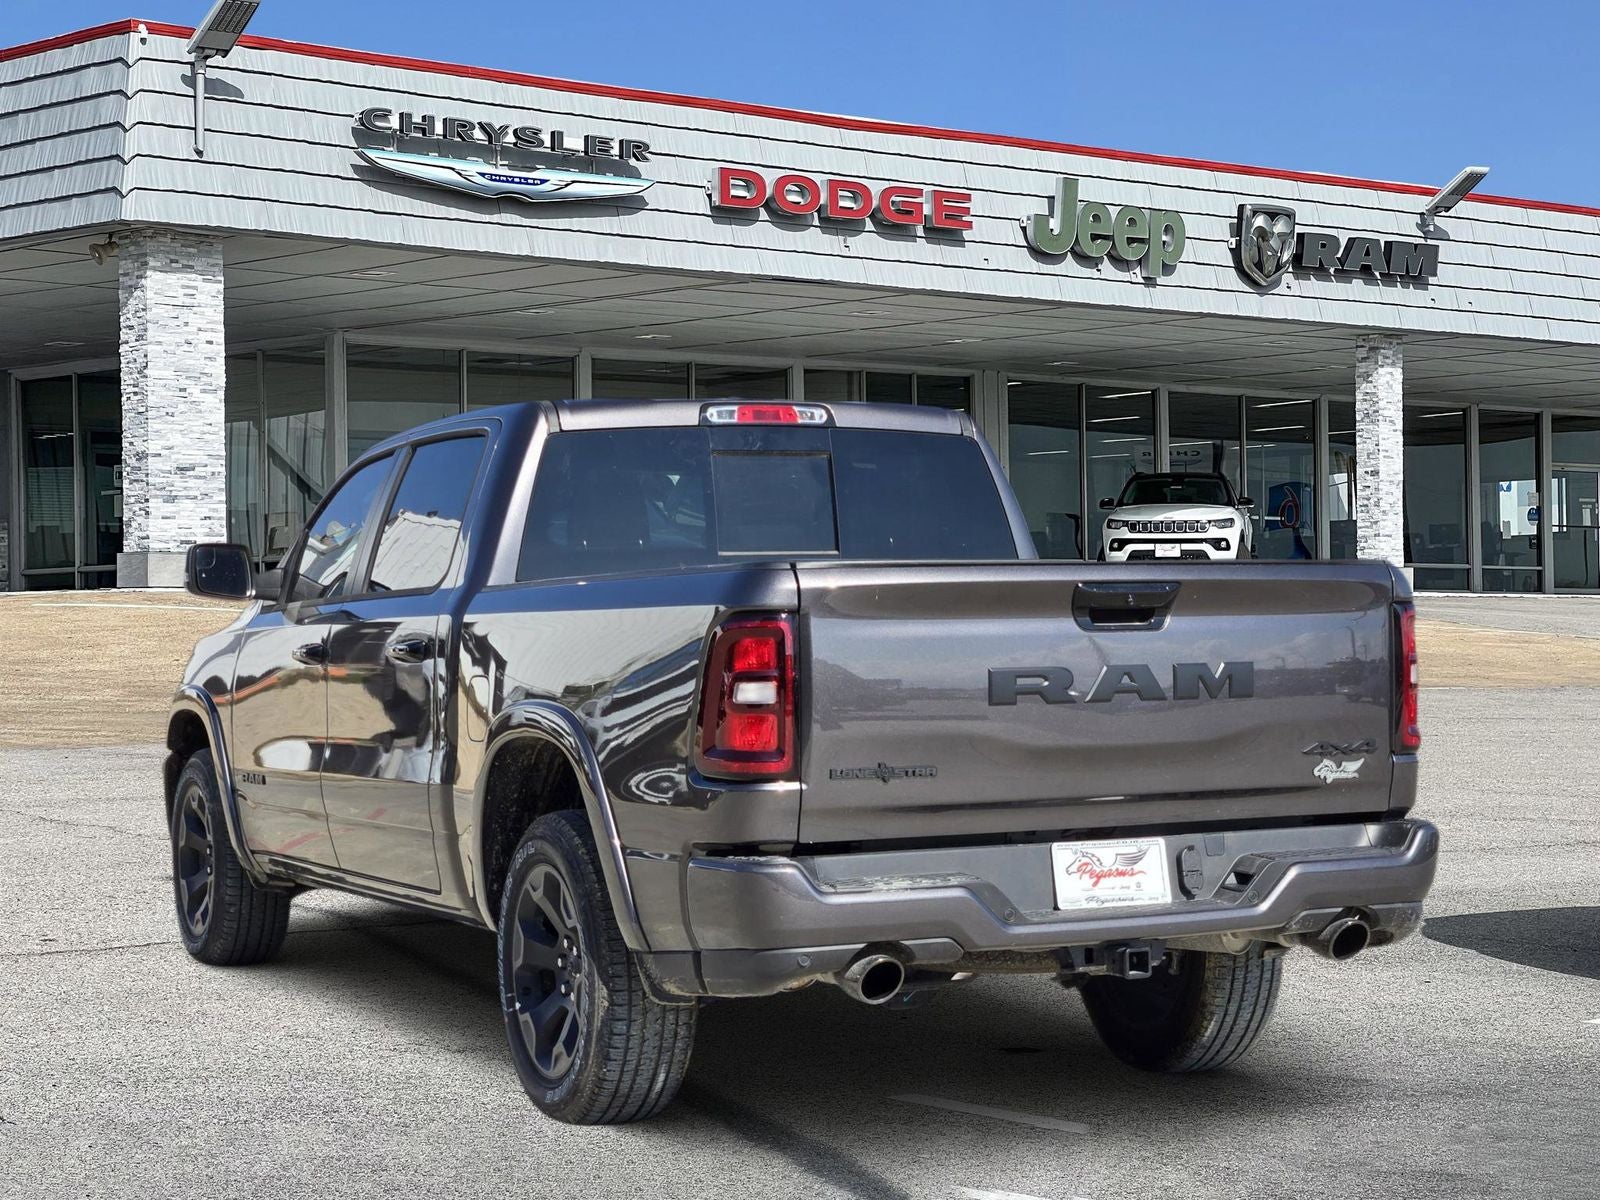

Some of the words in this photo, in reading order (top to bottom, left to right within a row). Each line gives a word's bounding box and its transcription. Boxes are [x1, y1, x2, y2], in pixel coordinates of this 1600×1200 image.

[354, 106, 651, 163] CHRYSLER
[484, 174, 542, 185] CHRYSLER
[711, 166, 974, 231] DODGE
[1025, 177, 1187, 279] Jeep
[1296, 232, 1440, 278] RAM
[988, 661, 1255, 706] RAM
[241, 772, 267, 786] RAM
[1076, 861, 1147, 888] Pegasus
